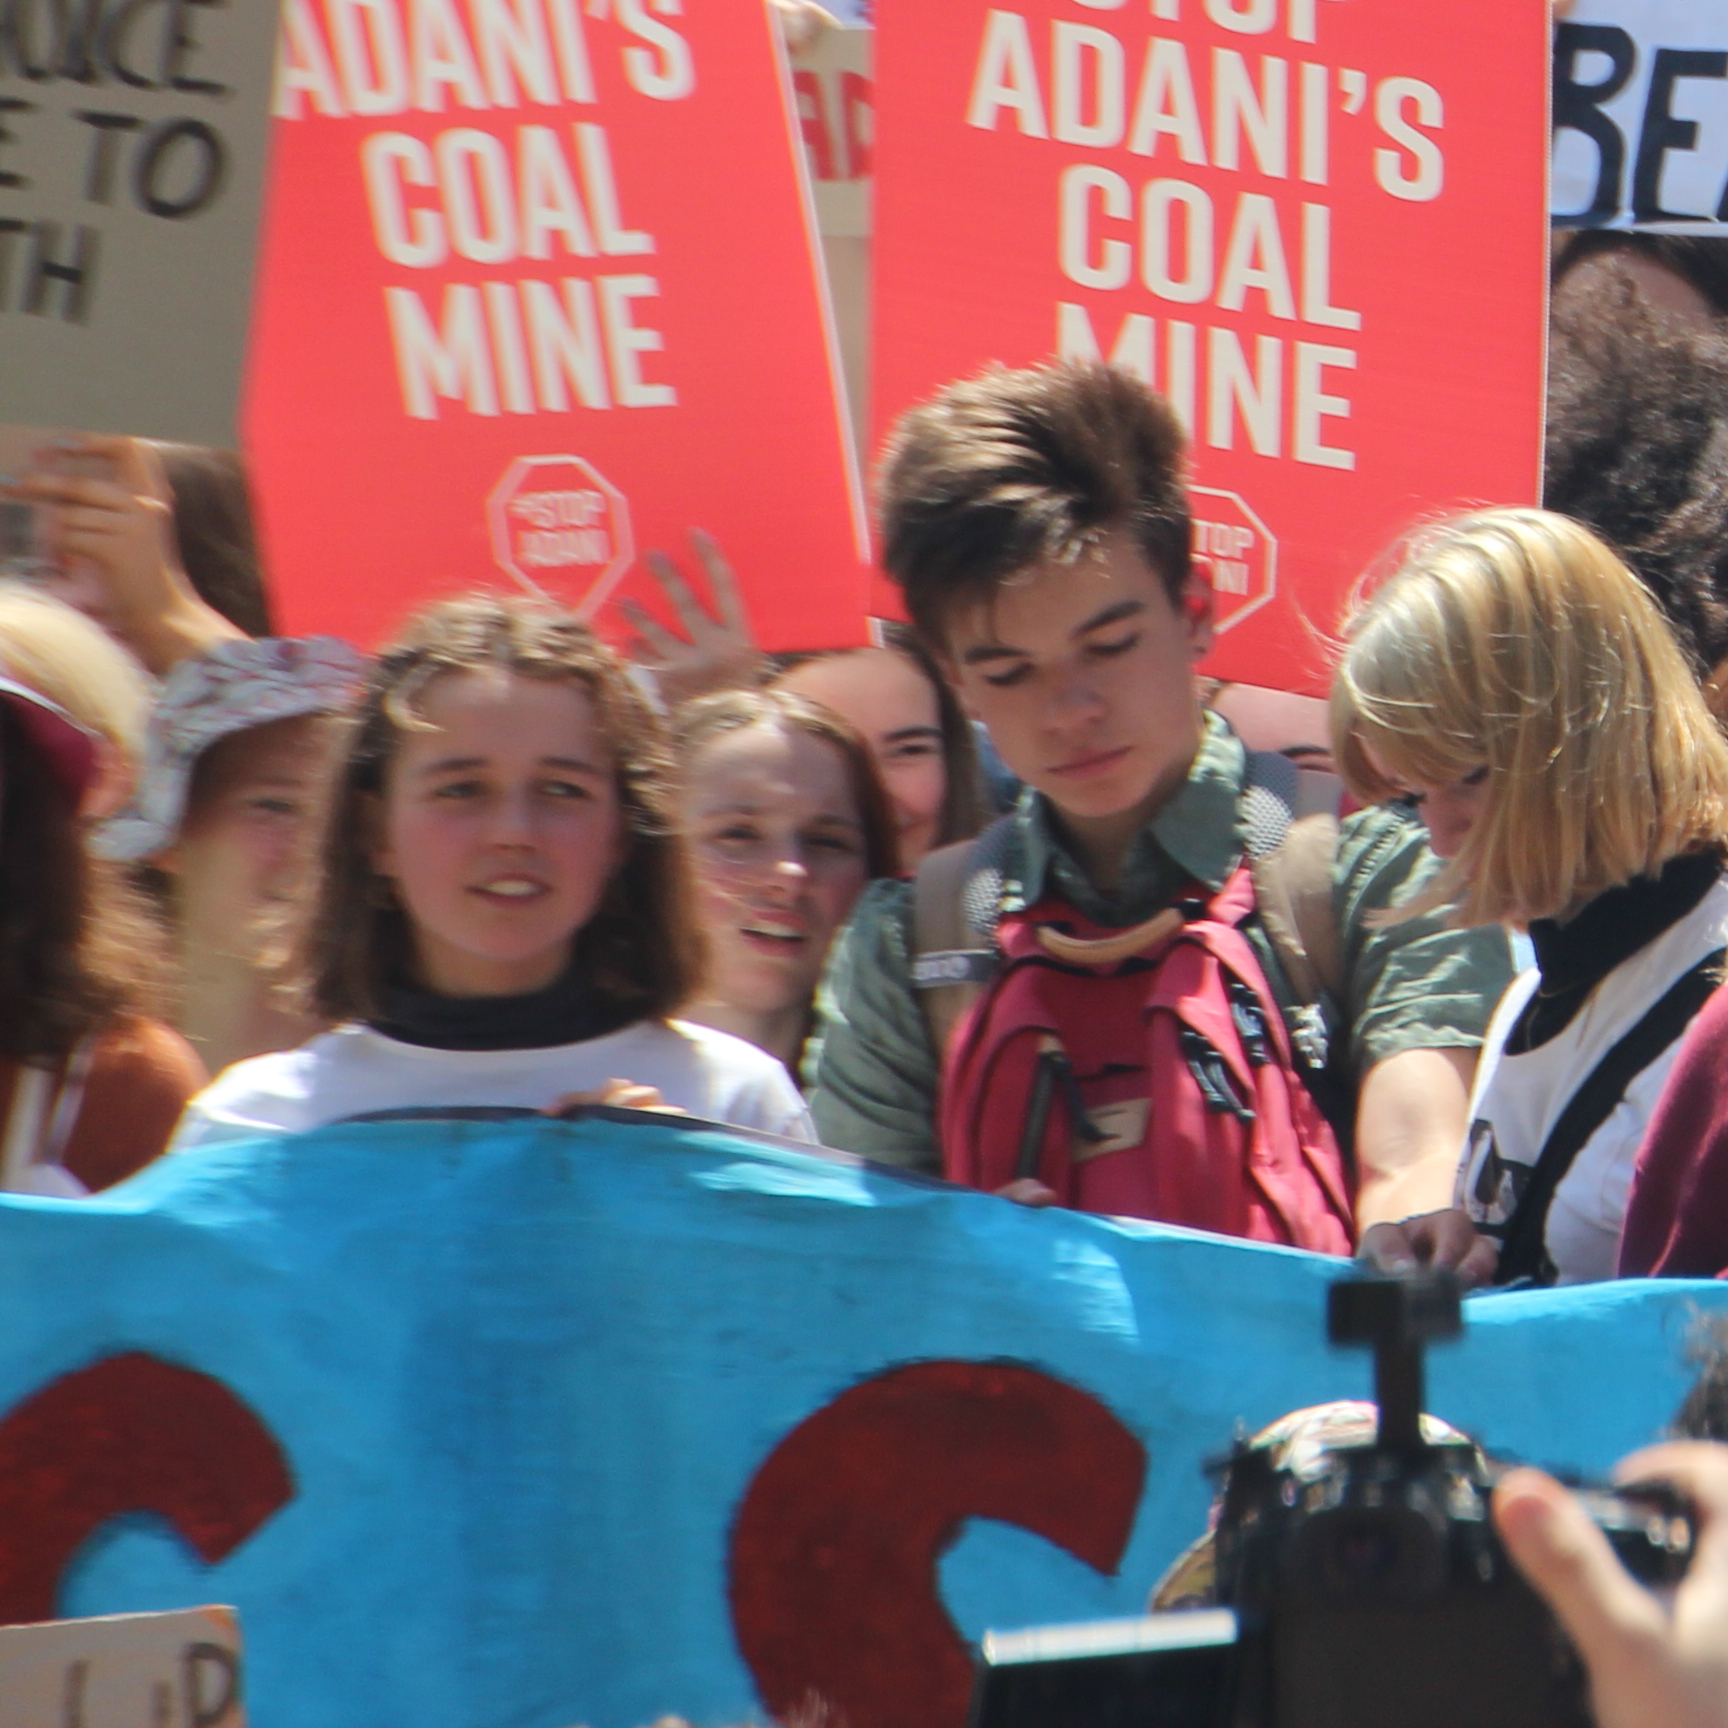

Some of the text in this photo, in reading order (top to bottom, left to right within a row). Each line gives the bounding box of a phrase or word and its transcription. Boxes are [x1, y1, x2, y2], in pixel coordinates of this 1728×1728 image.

[72, 106, 226, 222] TO
[964, 7, 1447, 204] ADANI'S
[359, 120, 658, 269] COAL
[1057, 161, 1364, 333] COAL
[383, 273, 679, 422] MINE
